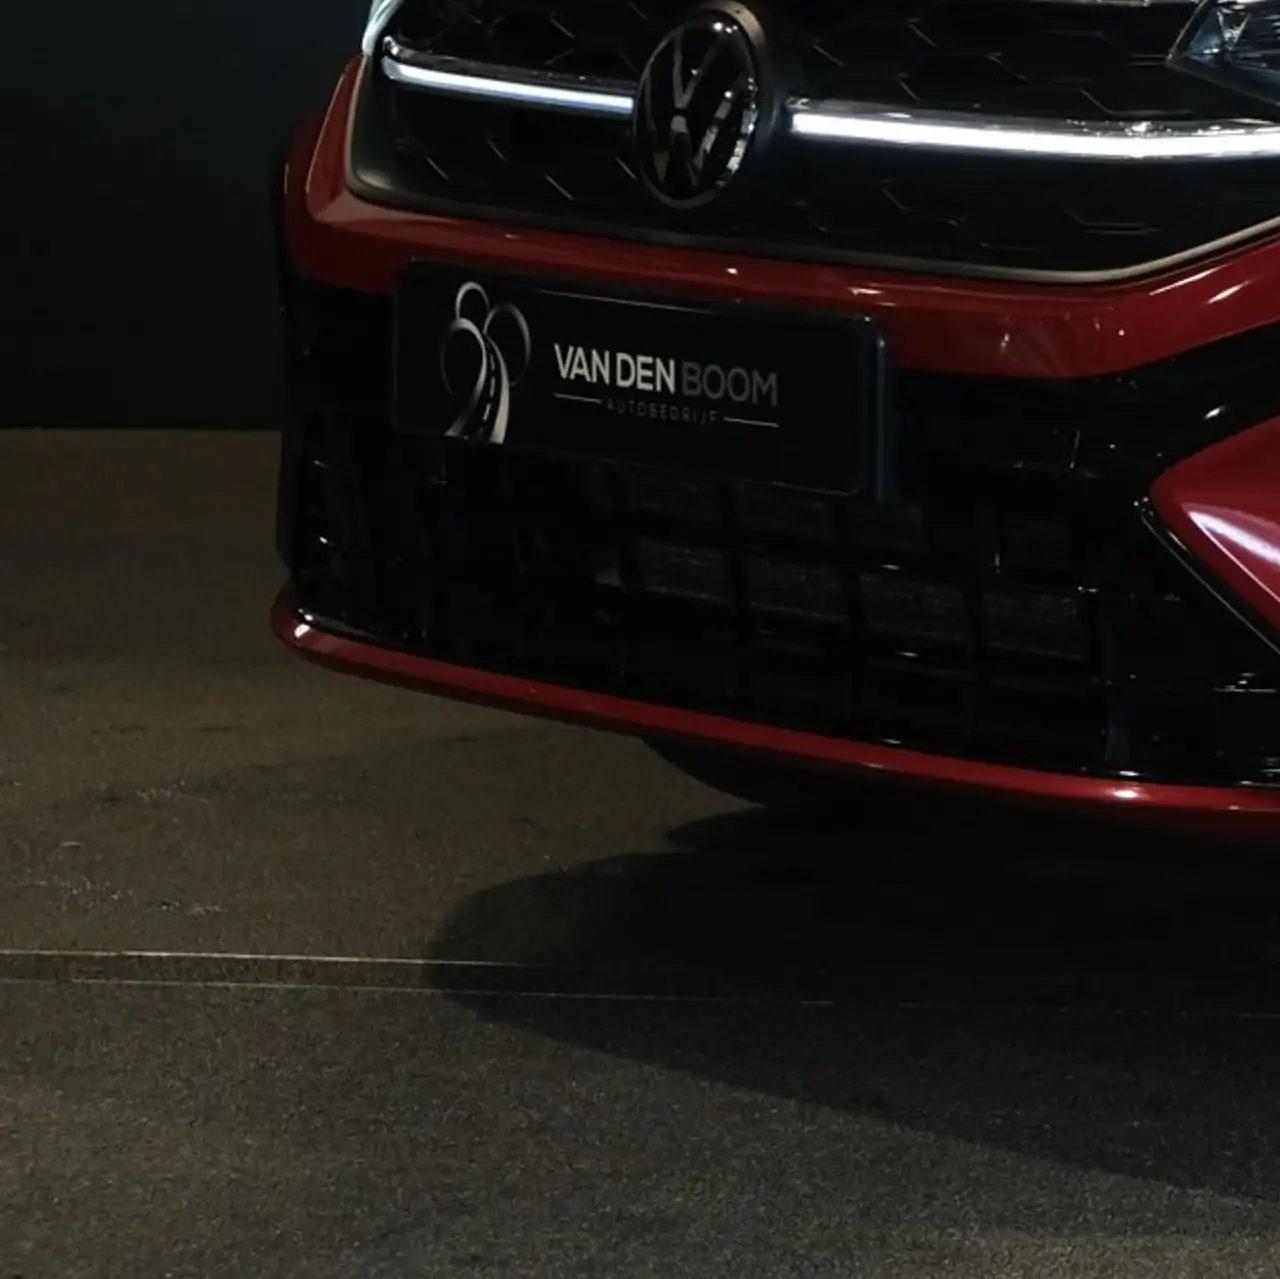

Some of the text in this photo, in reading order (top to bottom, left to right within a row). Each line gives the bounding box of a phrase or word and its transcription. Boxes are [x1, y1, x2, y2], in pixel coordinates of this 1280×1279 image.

[553, 341, 778, 407] VAN DEN BOOM
